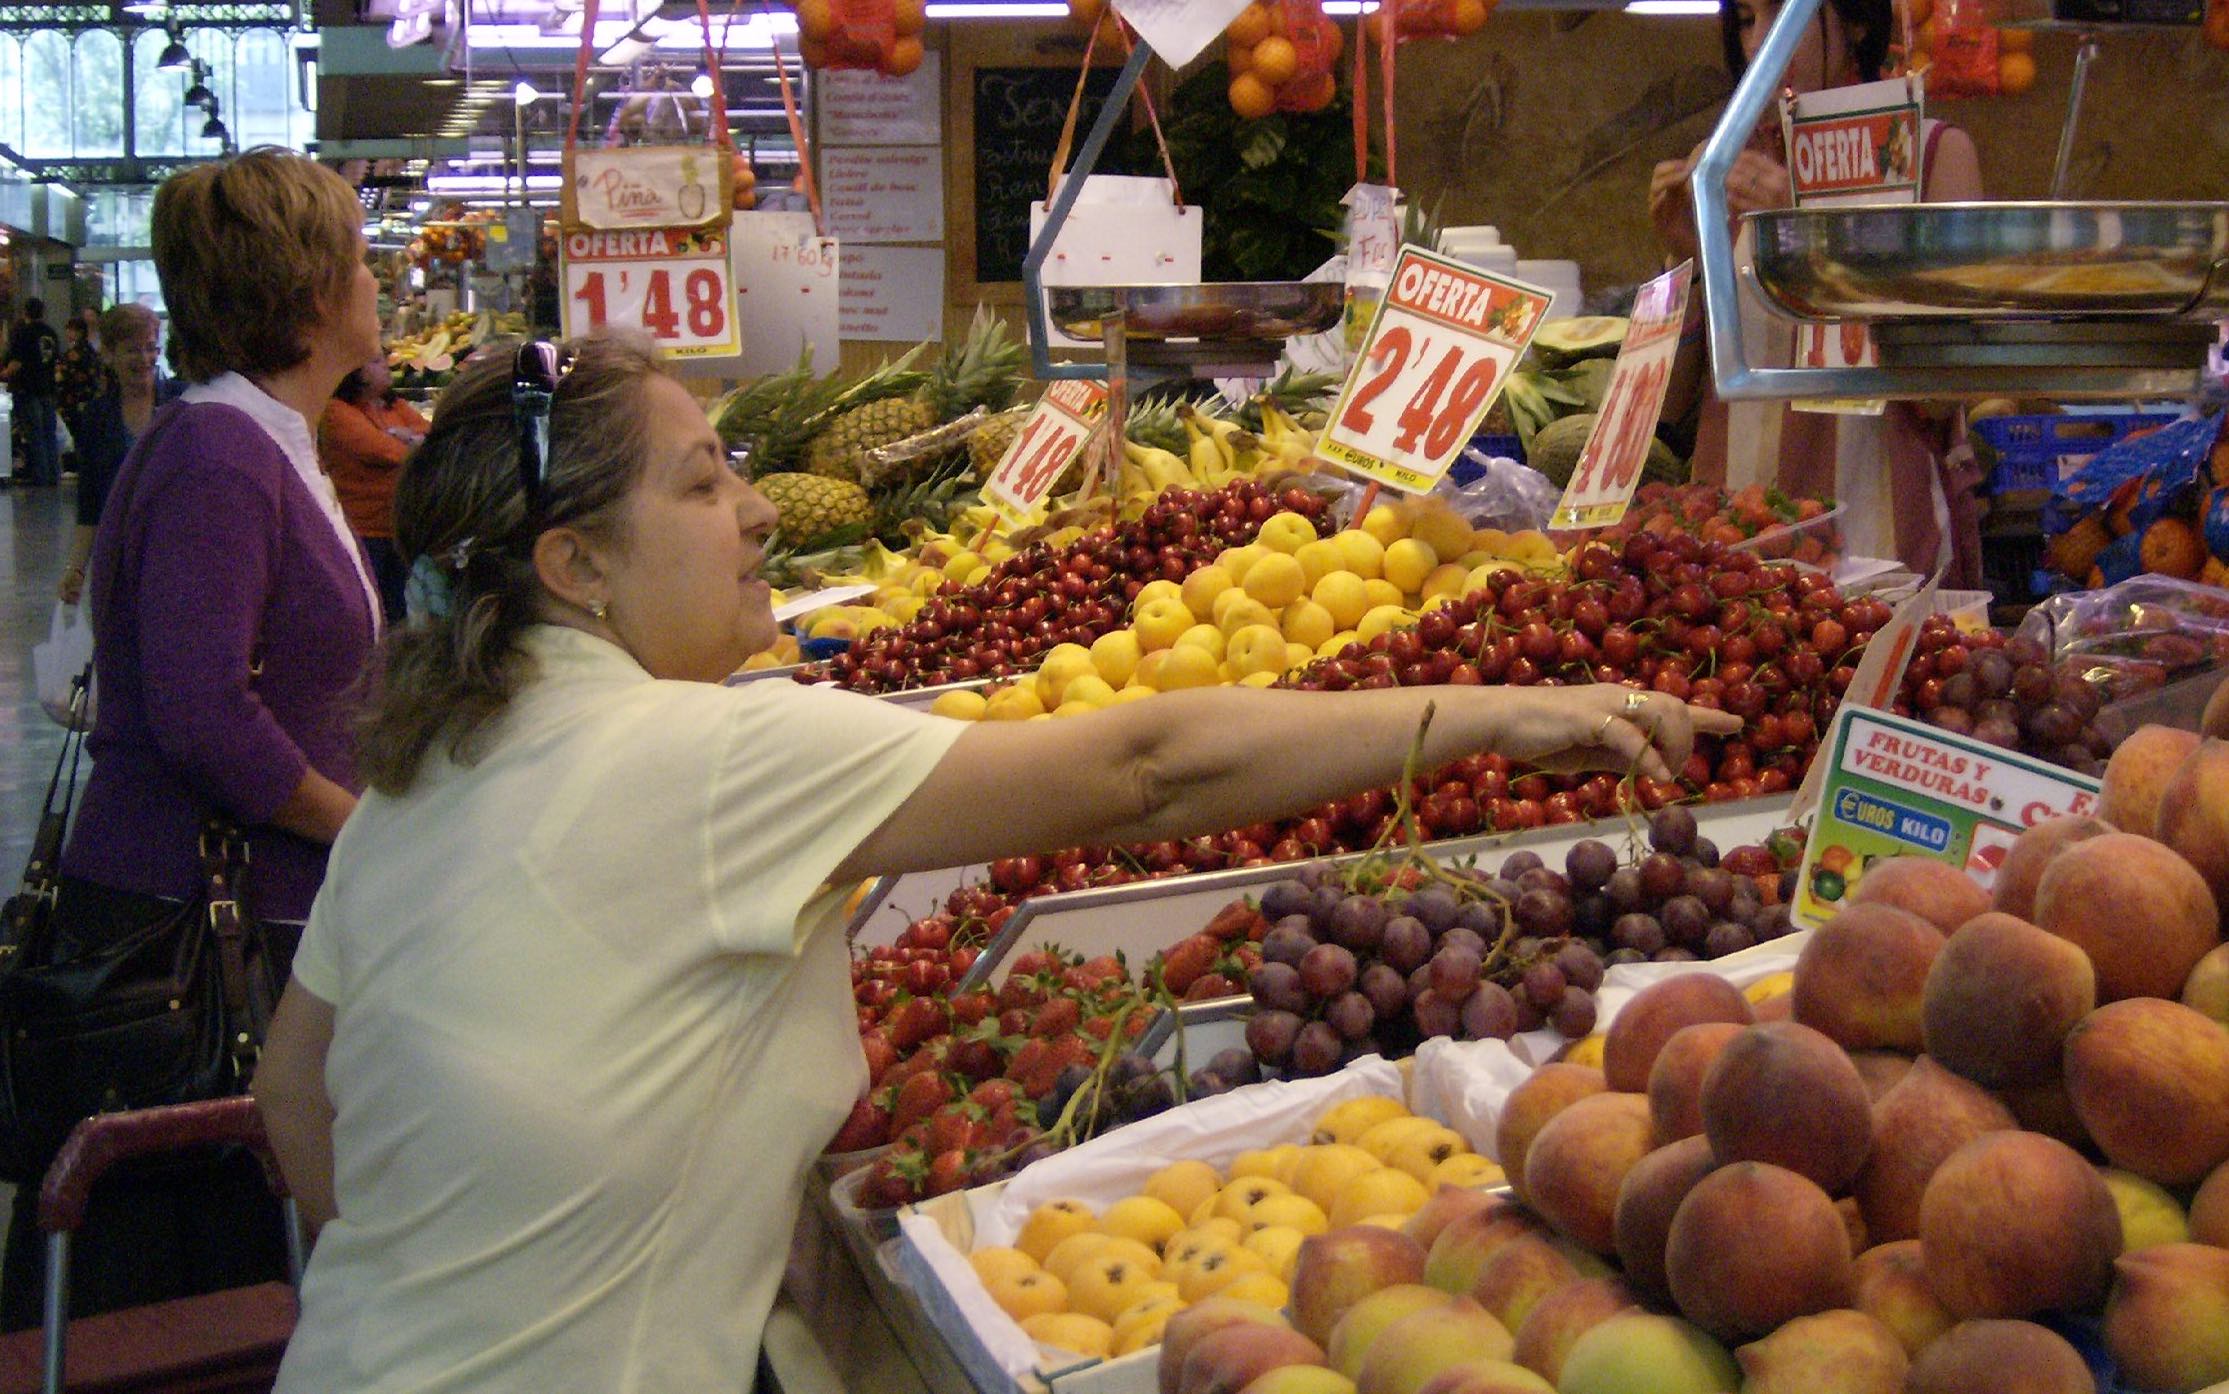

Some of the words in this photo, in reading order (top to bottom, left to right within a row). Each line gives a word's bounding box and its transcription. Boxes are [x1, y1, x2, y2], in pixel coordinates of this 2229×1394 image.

[1796, 126, 1875, 184] OFERTA
[593, 168, 662, 210] Piña
[568, 230, 670, 257] OFERTA
[575, 268, 724, 338] 1'48
[1397, 263, 1491, 326] OFERTA
[1341, 325, 1497, 460] 2'48
[998, 413, 1077, 504] 1'48
[1853, 749, 1989, 806] VERDURAS
[1867, 730, 1969, 775] FRUTAS
[1974, 762, 1992, 782] Y
[1901, 816, 1945, 843] KILO
